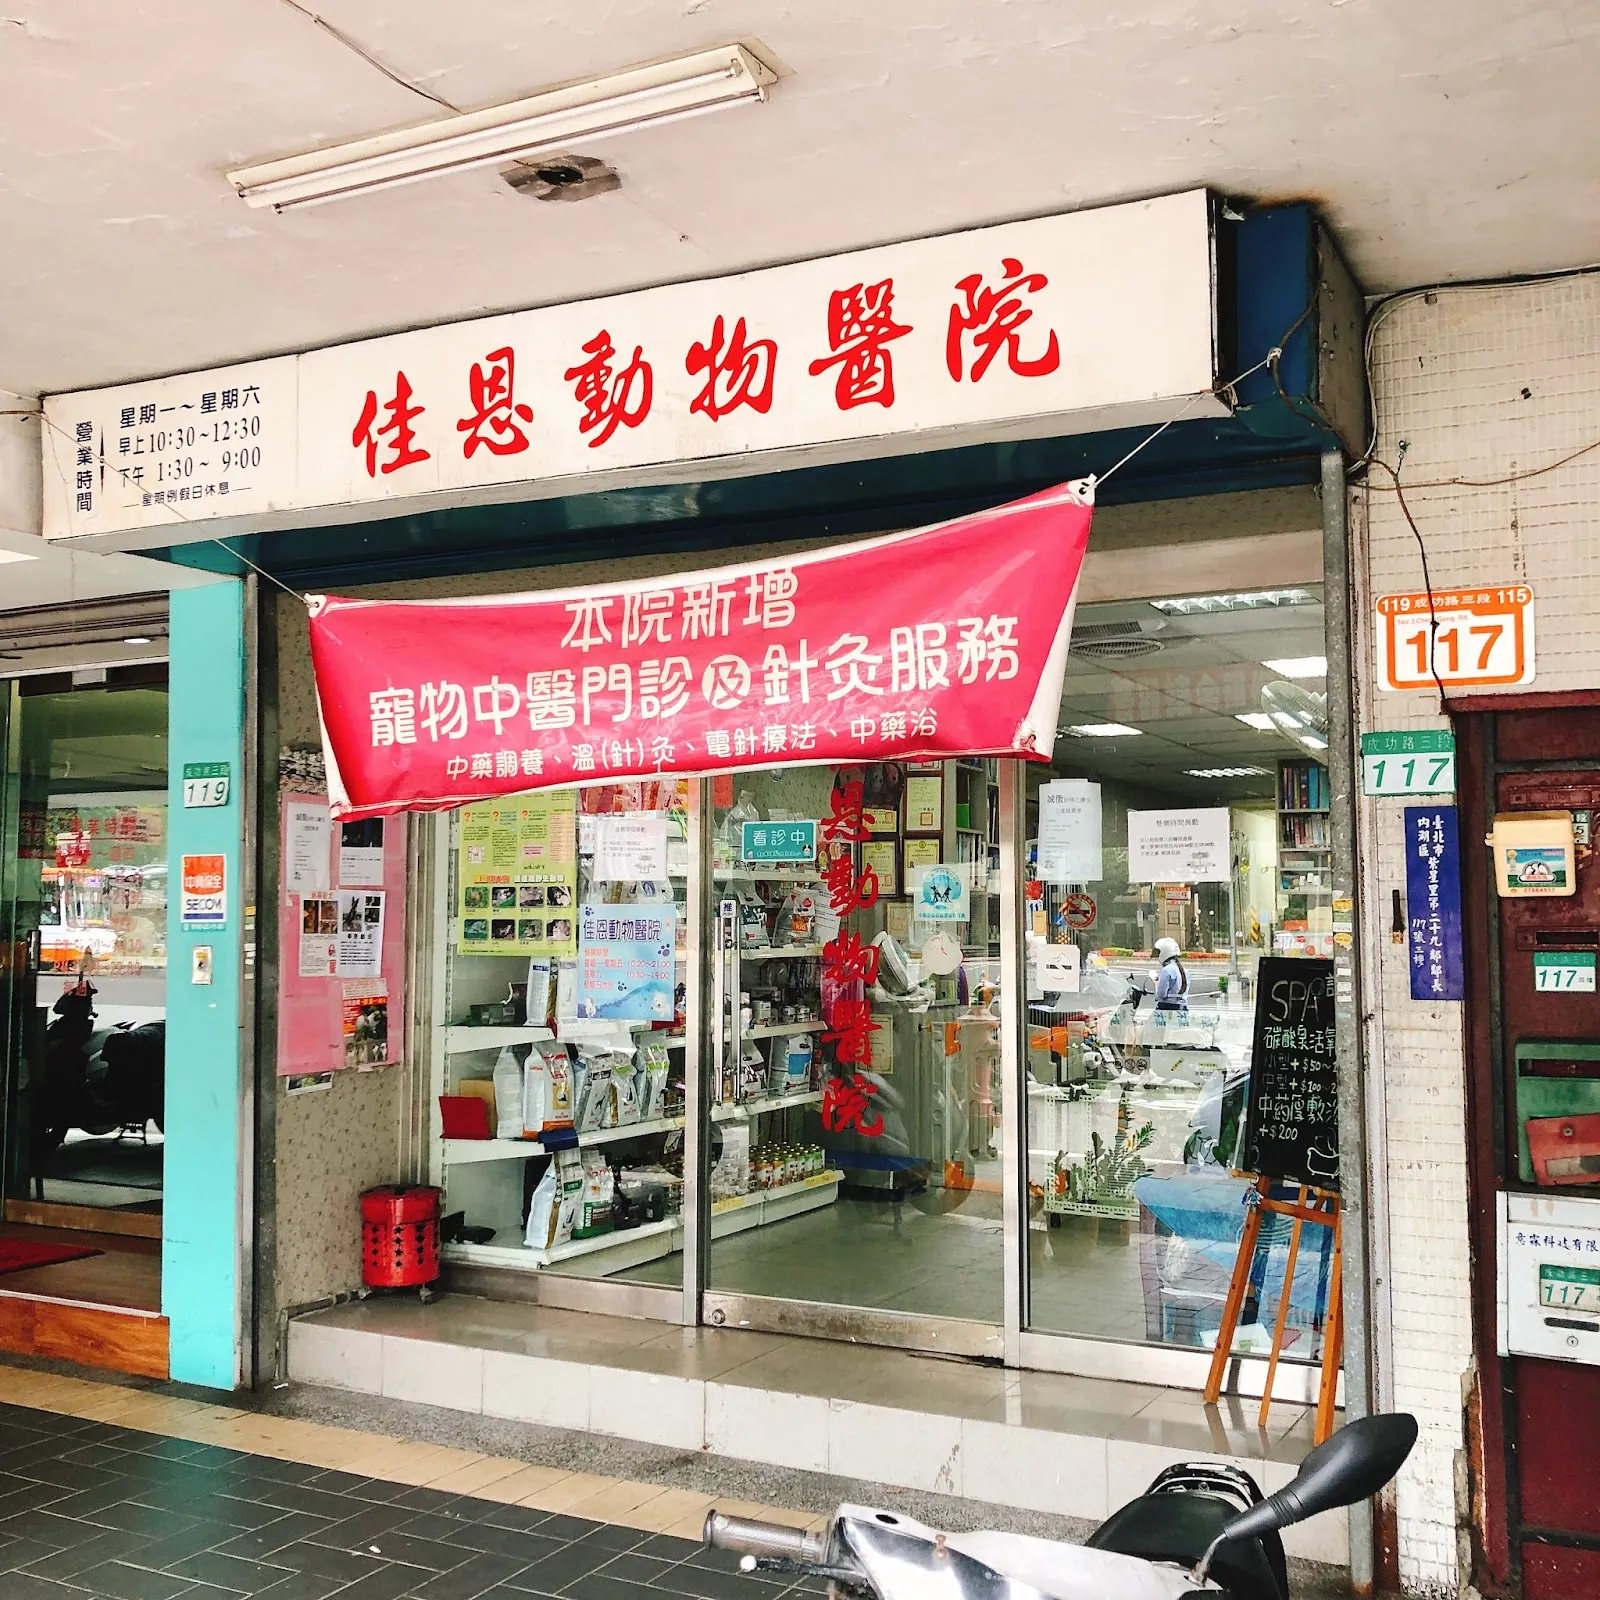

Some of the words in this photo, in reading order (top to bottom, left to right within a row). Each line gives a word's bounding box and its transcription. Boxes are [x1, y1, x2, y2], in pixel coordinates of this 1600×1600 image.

[352, 257, 1060, 477] 佳恩動物醫院
[75, 420, 93, 513] 營業時間
[561, 568, 798, 651] 本院新增
[1382, 597, 1410, 612] 119
[1414, 593, 1491, 609] 成功路三段
[1497, 588, 1528, 604] 115
[1406, 624, 1503, 674] 117
[369, 613, 1021, 748] 寵物中醫門診及針灸服務
[1367, 733, 1451, 751] 成功路三段
[1372, 758, 1450, 788] 117
[188, 781, 226, 802] 119
[753, 829, 805, 846] 看診中
[186, 898, 222, 910] SECOM
[723, 903, 733, 912] 推
[584, 919, 661, 941] 佳恩動物醫院
[820, 763, 883, 1137] 恩動物醫院
[1539, 969, 1577, 988] 117
[1269, 977, 1324, 1021] SPA
[1259, 1123, 1298, 1140] +$200
[1544, 1283, 1586, 1306] 117
